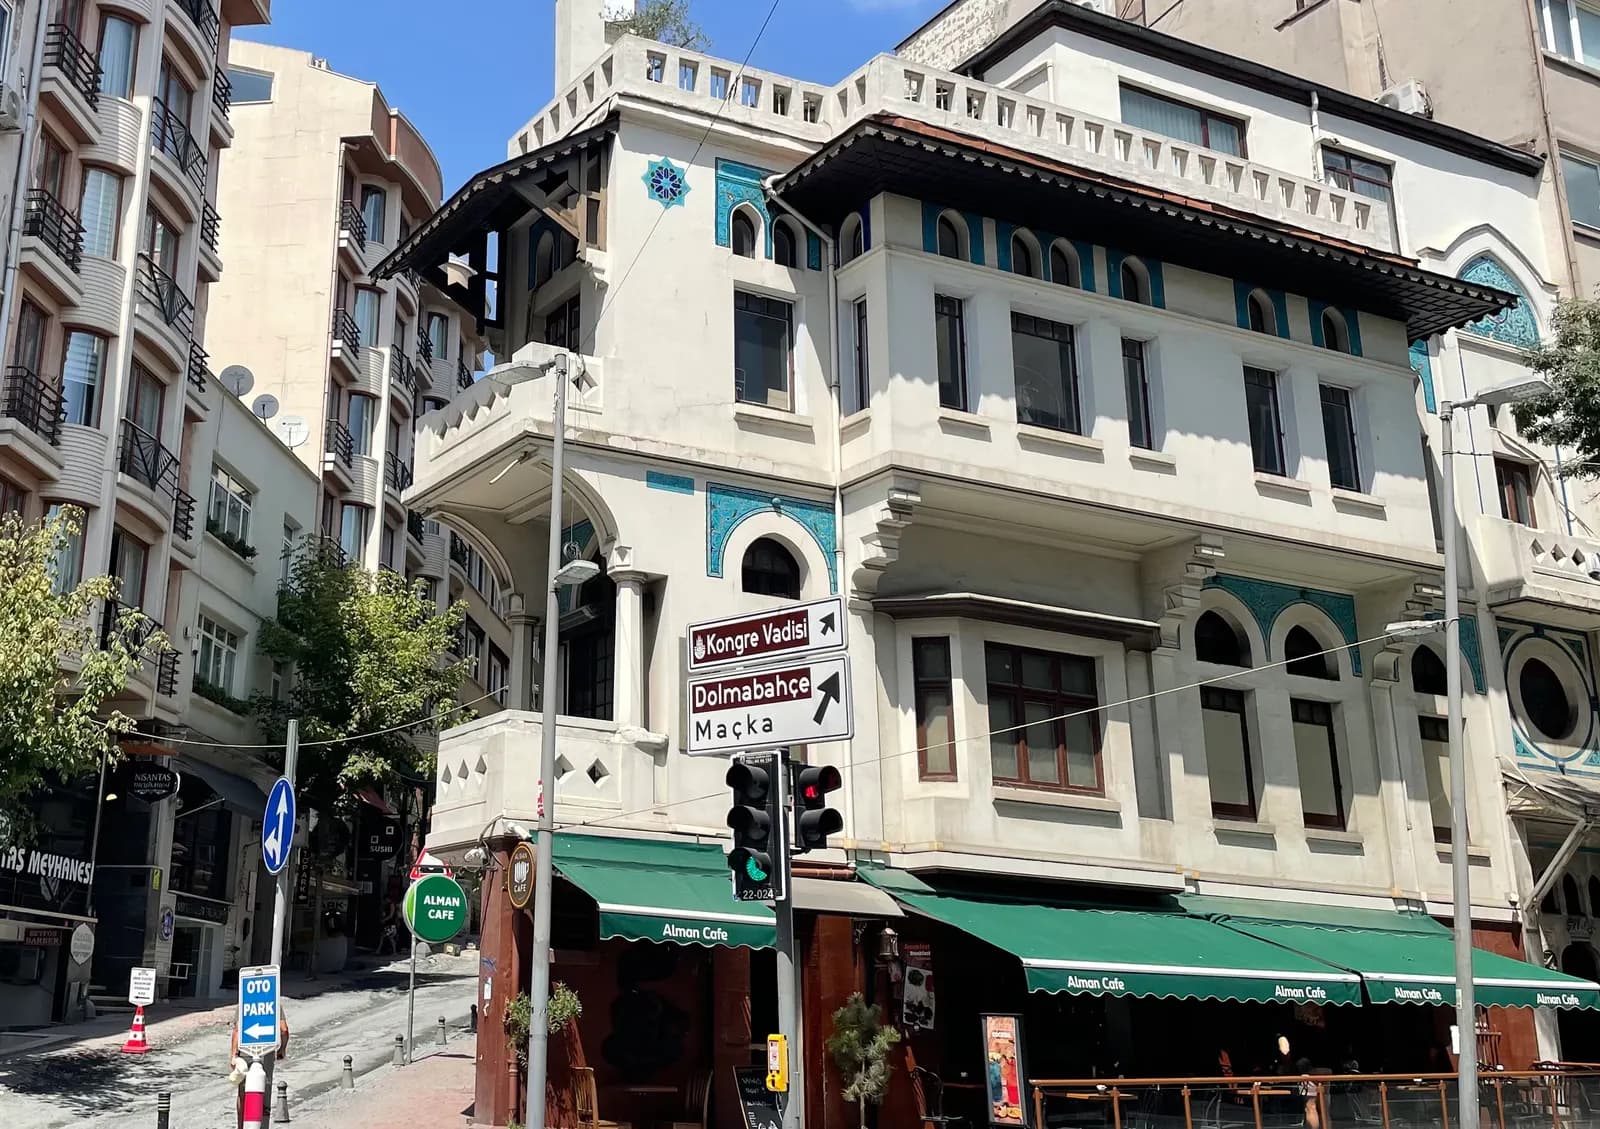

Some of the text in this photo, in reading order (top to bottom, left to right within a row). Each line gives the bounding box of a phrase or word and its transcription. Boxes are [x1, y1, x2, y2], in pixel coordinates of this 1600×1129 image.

[706, 617, 808, 656] Kongre Vadisi
[695, 674, 811, 708] Dolmabahçe
[695, 713, 774, 741] Maçka
[513, 883, 527, 893] CAFE
[742, 888, 774, 900] 22-024
[423, 895, 460, 907] ALMAN
[428, 909, 455, 920] CAFE
[662, 923, 728, 940] Alman Cafe
[246, 979, 271, 995] OTO
[1068, 975, 1125, 990] Alman Cafe
[1275, 985, 1326, 998] Alman Cafe
[1394, 987, 1442, 1000] Alman Cafe
[1536, 993, 1580, 1005] Alman Cafe
[243, 1001, 275, 1017] PARK
